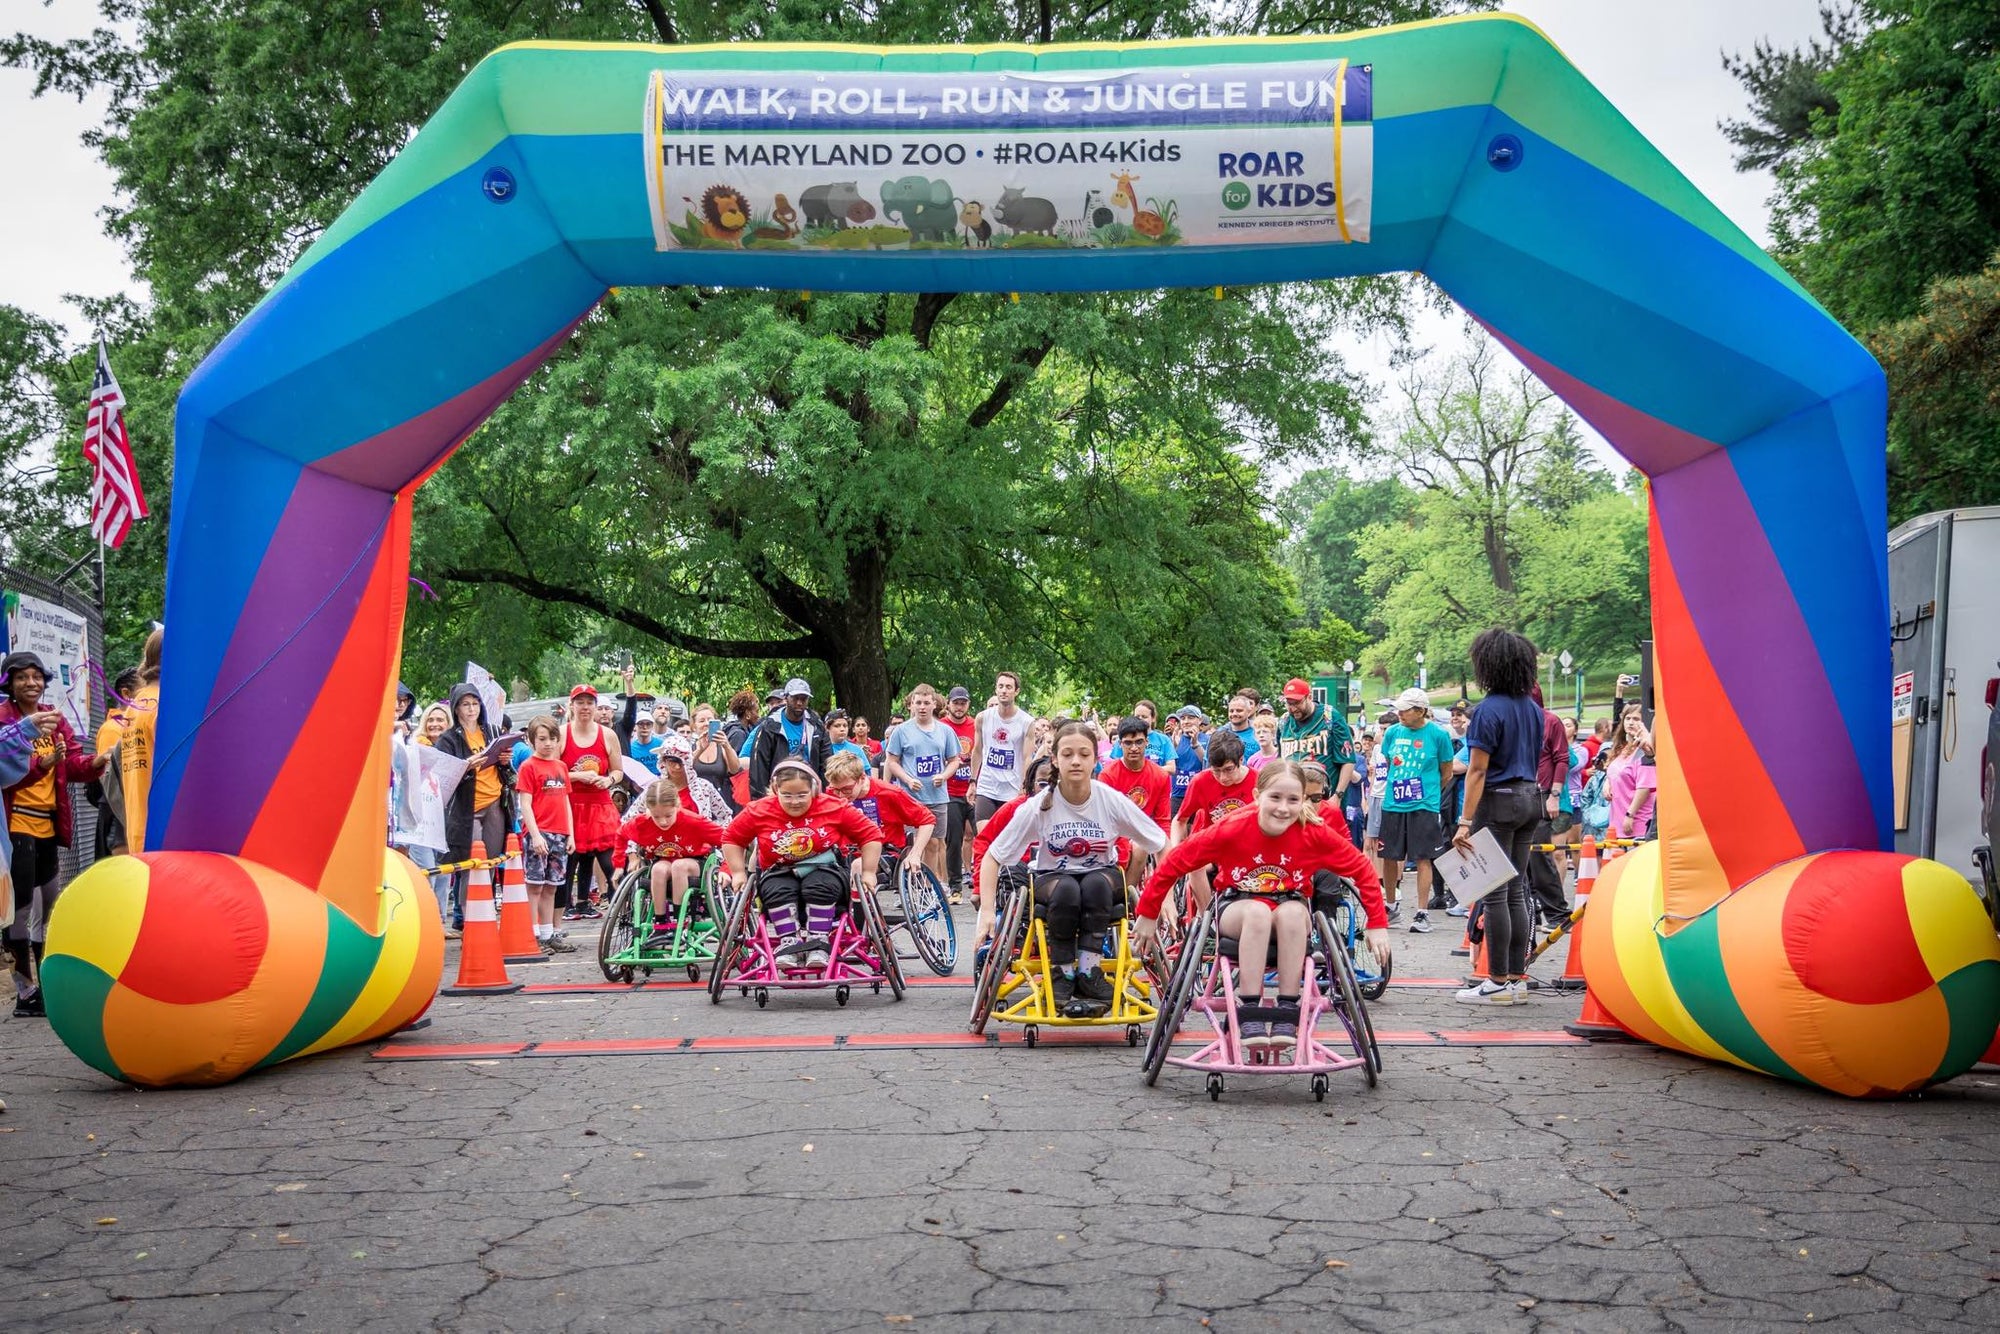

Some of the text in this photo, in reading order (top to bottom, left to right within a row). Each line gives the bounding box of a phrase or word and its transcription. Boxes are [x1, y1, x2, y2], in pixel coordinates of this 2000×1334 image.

[663, 78, 1347, 120] WALK, ROLL, RUN & JUNGLE FUN
[662, 139, 1181, 167] THE MARYLAND ZOO #ROAR4Kids
[1218, 151, 1304, 178] ROAR
[1224, 182, 1337, 208] for KIDS
[1218, 218, 1336, 229] KENNEDY KRIEGER INSTITUTE
[988, 753, 1005, 766] 590
[917, 761, 934, 773] 627
[955, 767, 972, 777] 483
[1176, 775, 1190, 786] 223
[1393, 784, 1413, 799] 374
[1053, 821, 1101, 831] INVITATIONAL
[1050, 829, 1106, 840] TRACK MEET
